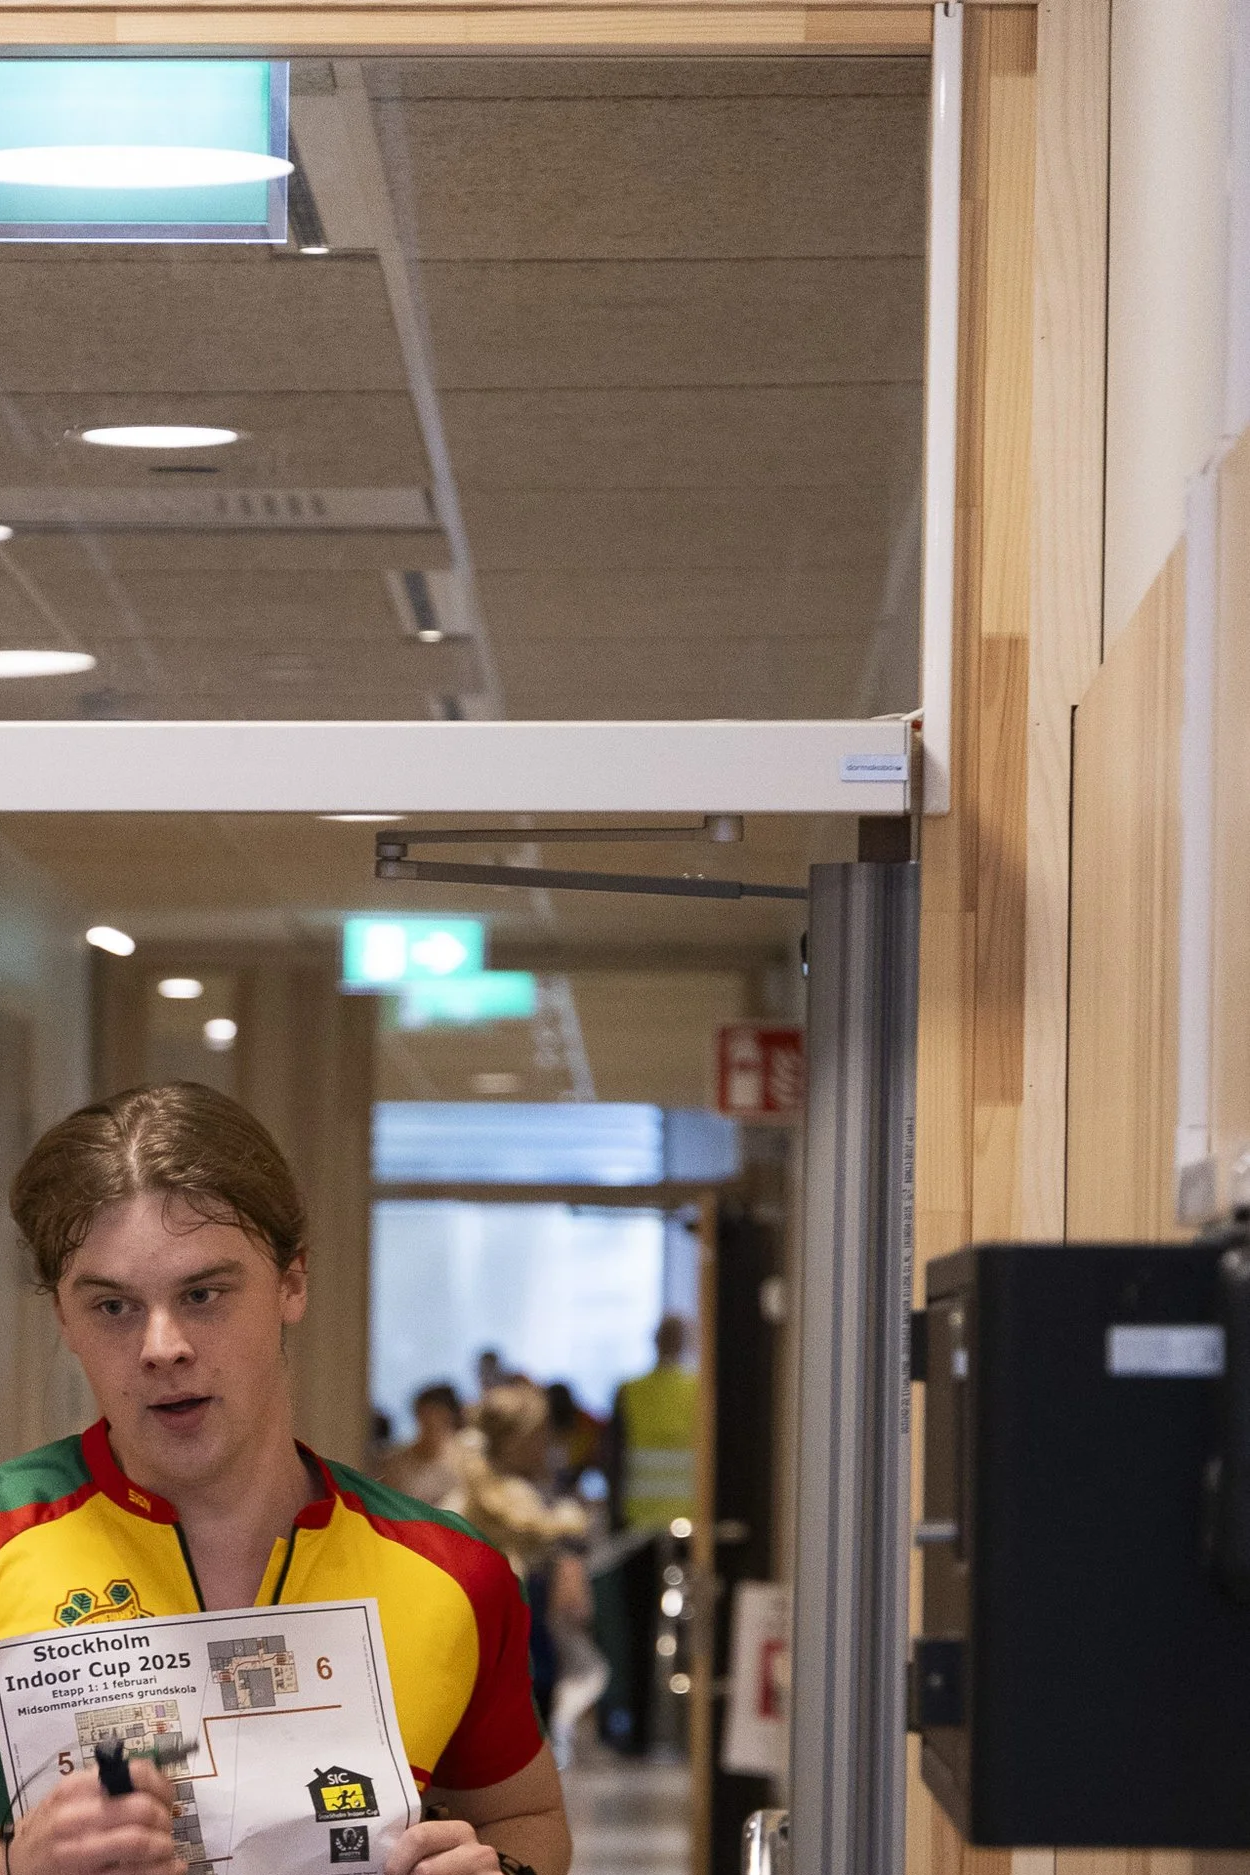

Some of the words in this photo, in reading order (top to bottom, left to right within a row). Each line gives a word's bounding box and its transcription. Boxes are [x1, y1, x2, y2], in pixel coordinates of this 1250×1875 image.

[33, 1634, 151, 1663] Stockholm
[5, 1667, 81, 1692] Indoor
[89, 1661, 131, 1679] Cup
[139, 1652, 191, 1672] 2025
[316, 1657, 333, 1681] 6
[52, 1686, 85, 1699] Etapp
[88, 1683, 99, 1693] 1:
[103, 1682, 109, 1690] 1
[113, 1676, 158, 1688] februari
[17, 1691, 135, 1716] Midsommarkransens
[137, 1685, 197, 1700] grundskola
[57, 1751, 75, 1776] 5
[327, 1772, 350, 1785] SIC
